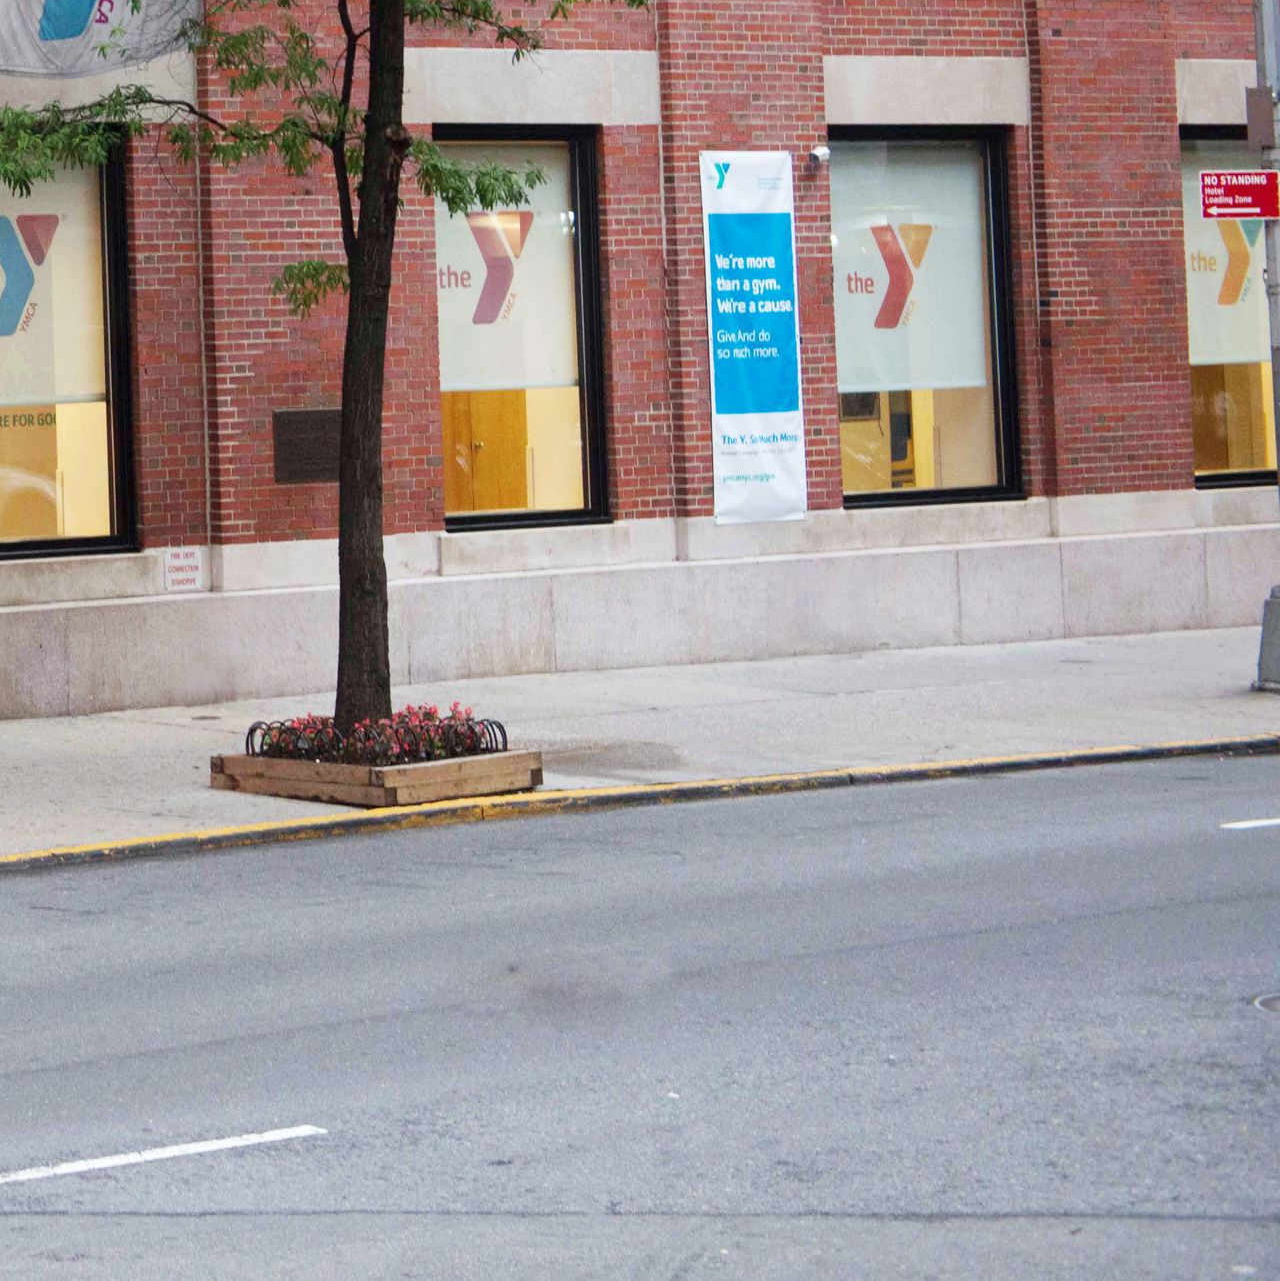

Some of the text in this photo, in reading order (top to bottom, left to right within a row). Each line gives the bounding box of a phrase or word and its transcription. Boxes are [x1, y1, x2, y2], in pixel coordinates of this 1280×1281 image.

[1204, 174, 1267, 185] NO STANDING
[1205, 187, 1224, 195] Hotel
[1205, 195, 1252, 205] Loading Zone
[746, 256, 776, 269] more
[1191, 252, 1217, 272] the
[437, 265, 471, 289] the
[846, 271, 874, 294] the
[743, 278, 750, 291] a
[752, 278, 781, 295] gym.
[501, 292, 518, 321] YMCA
[749, 300, 756, 313] a
[758, 299, 793, 312] cause.
[18, 301, 39, 333] YMCA
[737, 328, 756, 342] And
[758, 328, 771, 341] do
[717, 348, 730, 359] so
[753, 347, 780, 358] more.
[13, 414, 34, 427] FOR
[721, 433, 737, 444] The
[168, 565, 199, 573] CONNECTION
